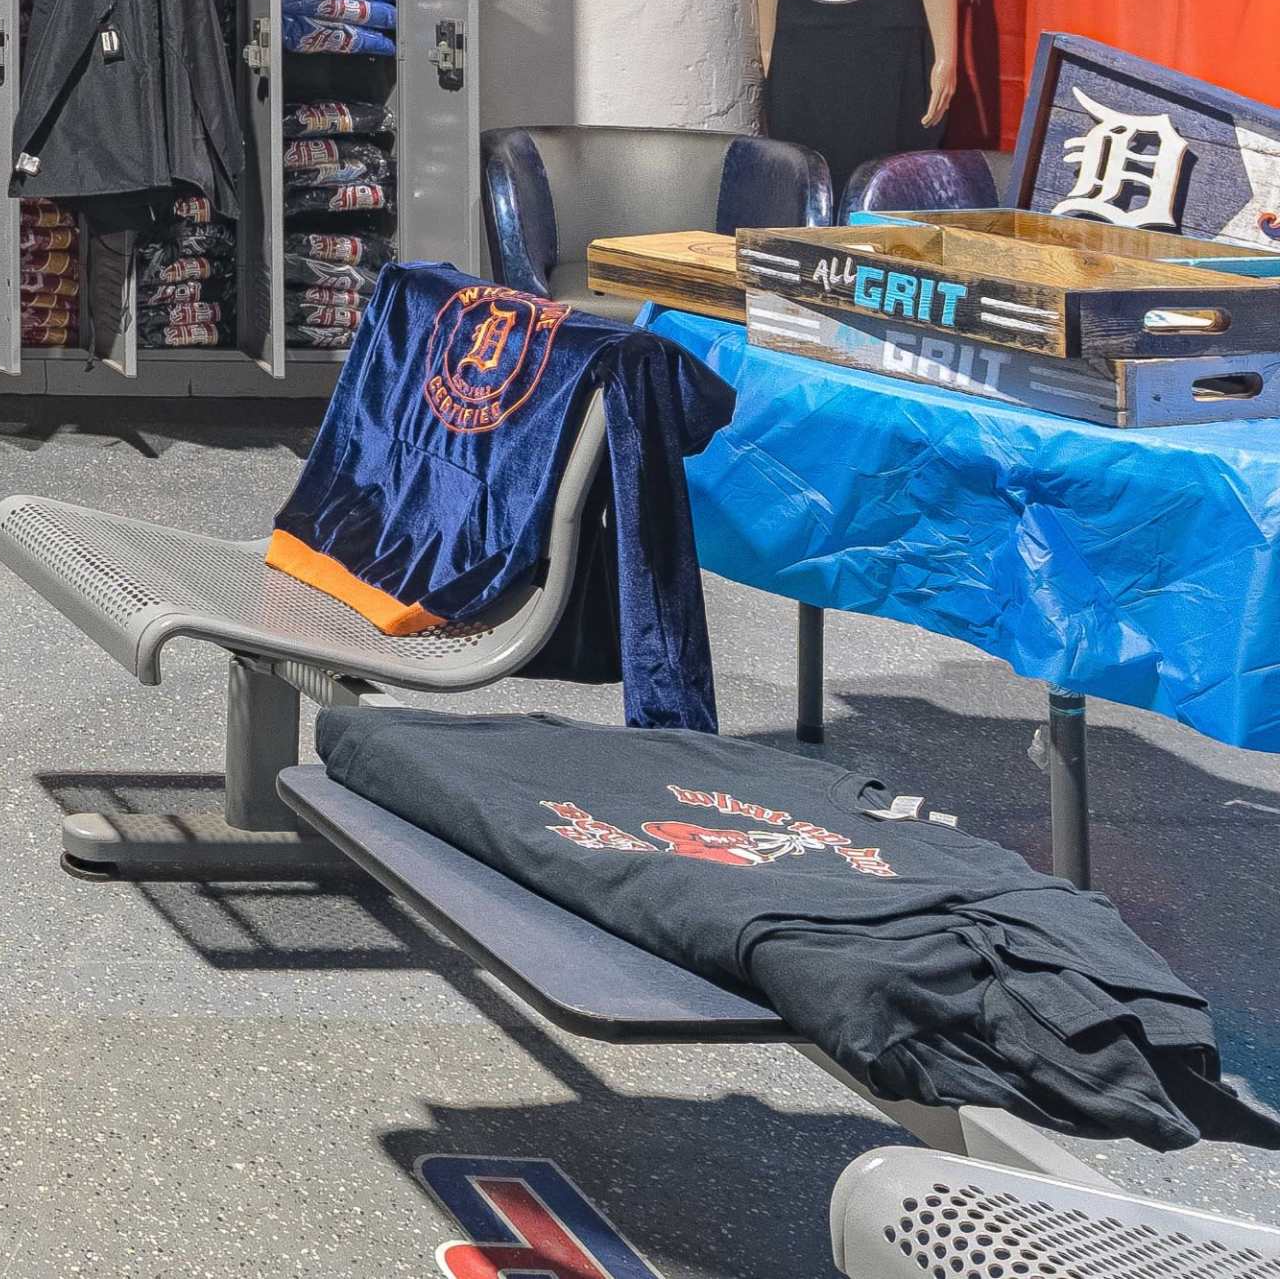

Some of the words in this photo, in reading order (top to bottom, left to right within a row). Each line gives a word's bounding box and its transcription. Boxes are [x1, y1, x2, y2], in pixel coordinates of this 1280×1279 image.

[813, 256, 857, 293] ALL
[853, 263, 969, 328] GRIT
[881, 329, 1013, 393] GRIT
[428, 375, 503, 429] CERTIFIED
